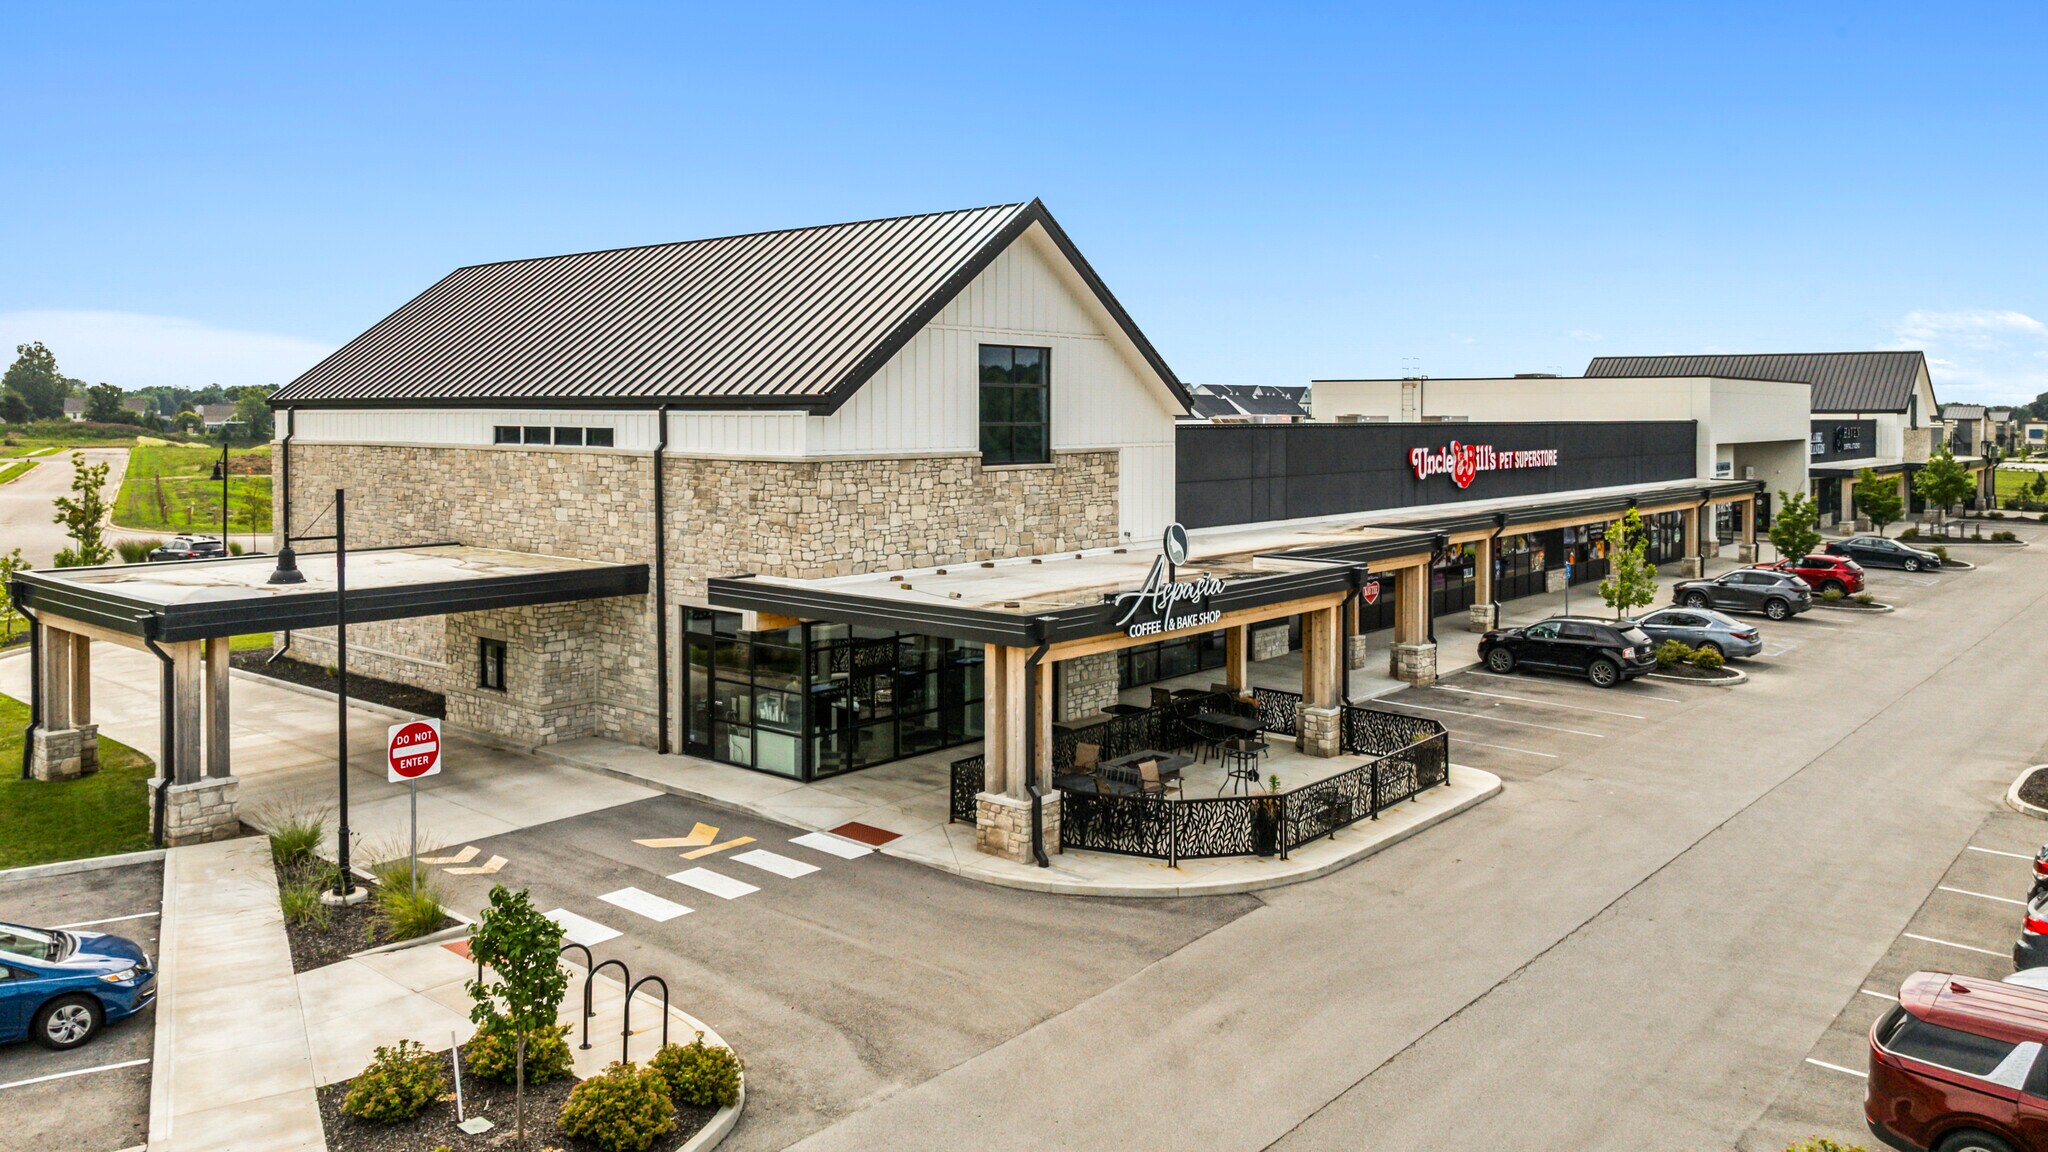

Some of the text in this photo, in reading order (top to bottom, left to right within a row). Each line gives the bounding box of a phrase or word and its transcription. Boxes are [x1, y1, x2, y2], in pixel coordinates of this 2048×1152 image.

[1410, 445, 1558, 480] Uncle Bill's PET SUPERSTORE
[1115, 554, 1226, 632] Aspasia
[1129, 609, 1221, 638] COFFEE & BAKE SHOP
[397, 731, 432, 745] DO NOT
[400, 756, 429, 769] ENTER
